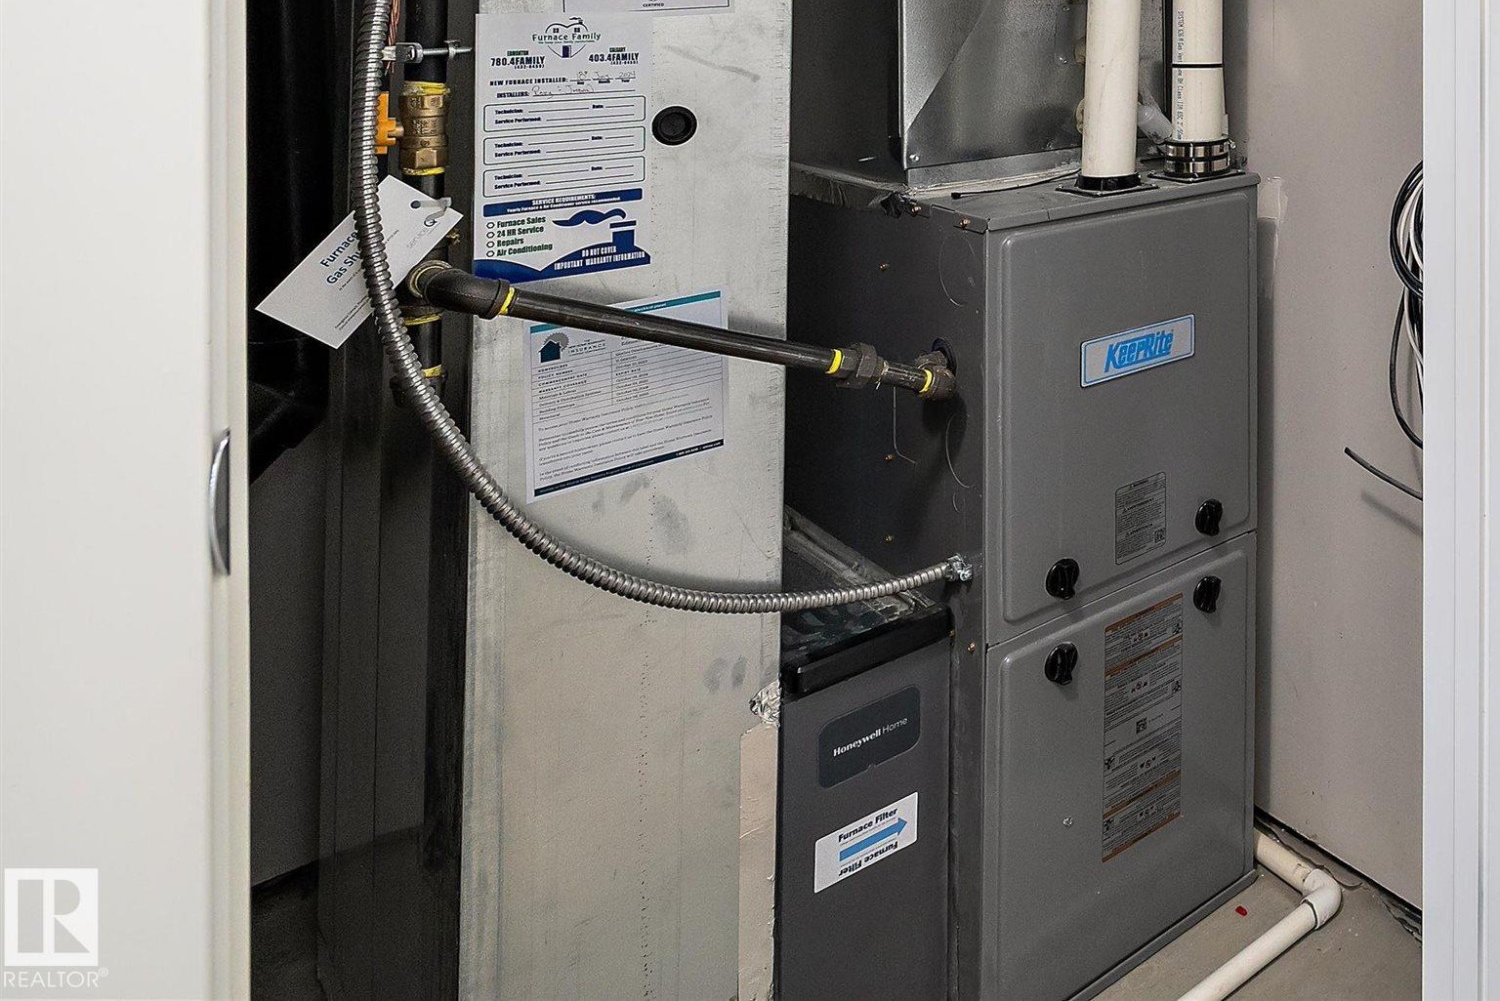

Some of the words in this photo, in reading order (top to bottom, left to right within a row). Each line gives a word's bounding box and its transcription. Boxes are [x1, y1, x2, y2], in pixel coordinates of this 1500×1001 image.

[532, 33, 568, 41] Furnace
[572, 32, 601, 42] Family
[490, 56, 545, 66] 780.4FAMILY
[589, 53, 639, 62] 403.4FAMILY
[497, 218, 525, 228] Furnace
[527, 216, 546, 225] Sales
[497, 229, 506, 238] 24
[507, 227, 516, 235] HR
[517, 226, 544, 234] Service
[320, 231, 360, 267] Furnace
[497, 237, 524, 248] Repairs
[497, 248, 507, 257] Air
[508, 243, 553, 256] Conditioning
[590, 248, 599, 256] NOT
[600, 246, 617, 254] COVER
[554, 260, 583, 270] IMPORTANT
[586, 255, 612, 266] WARRANTY
[613, 251, 645, 262] INFORMATION
[326, 266, 346, 284] Gas
[567, 342, 605, 354] INSURANCE
[833, 728, 882, 757] Honeywell
[882, 716, 908, 734] Home
[838, 819, 873, 843] Furnace
[875, 808, 898, 824] Filter
[864, 841, 898, 864] Furnace
[839, 860, 862, 876] Filter
